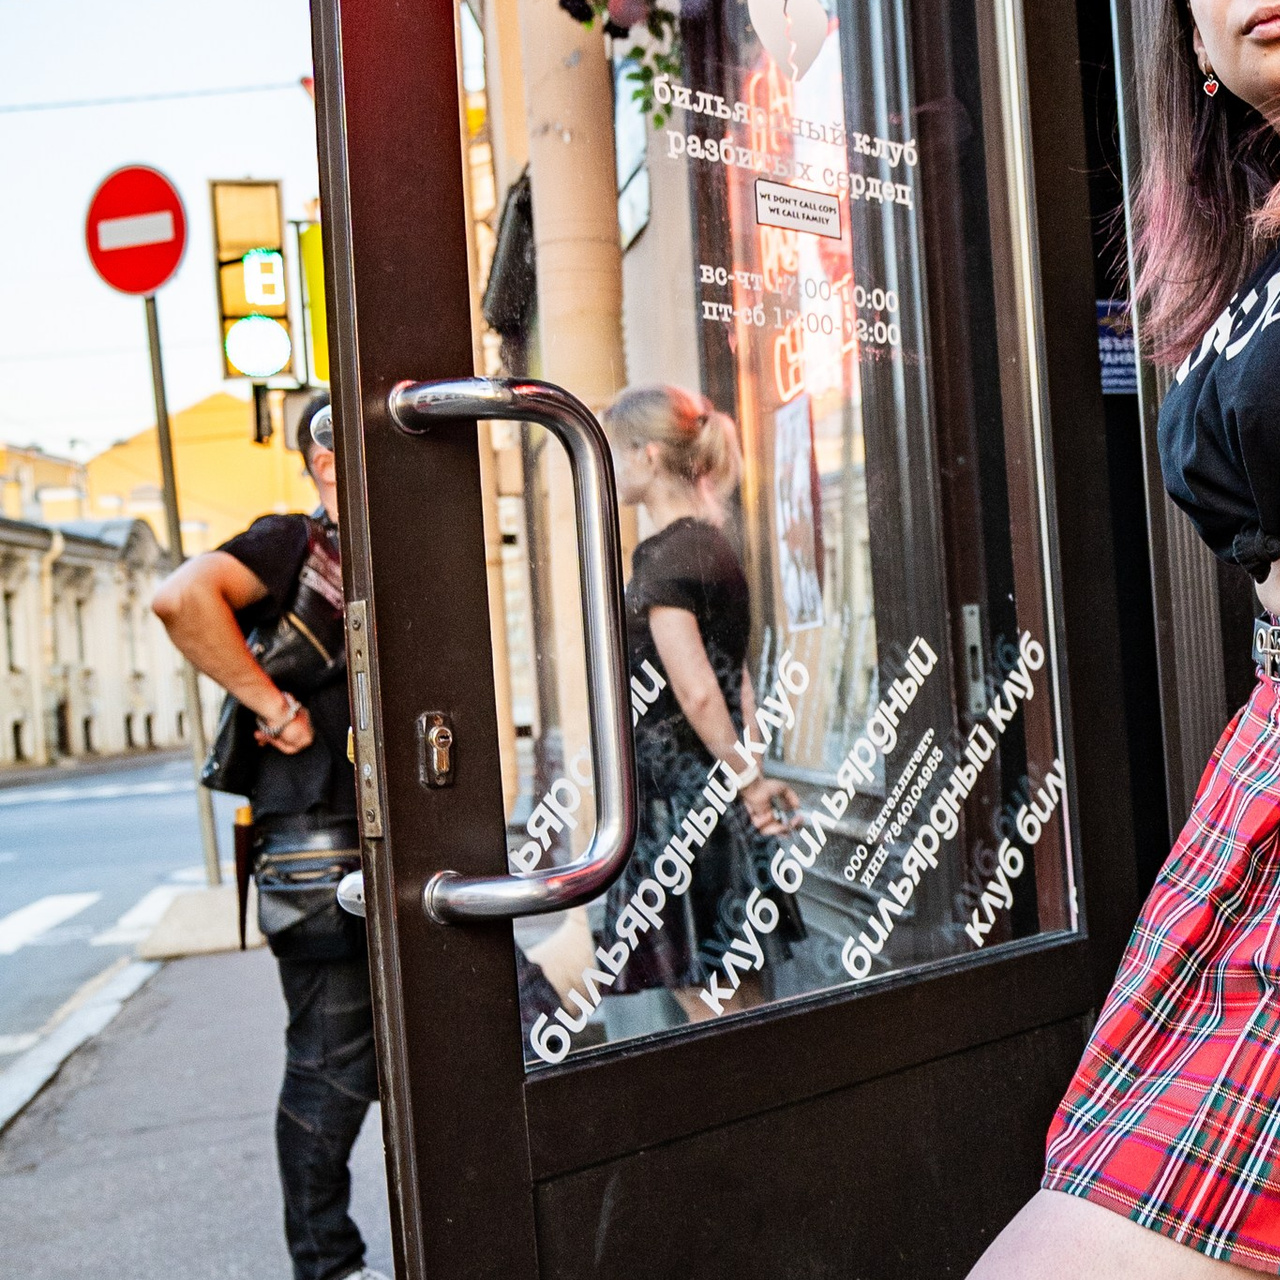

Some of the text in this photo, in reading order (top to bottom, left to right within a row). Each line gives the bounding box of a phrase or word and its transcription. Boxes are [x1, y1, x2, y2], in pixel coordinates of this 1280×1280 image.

[653, 73, 918, 168] бильярдный клуб
[666, 129, 914, 211] разбитых сердец
[760, 192, 837, 215] WE DON'T CALL COPS
[769, 206, 830, 225] WE CALL FAMILY
[699, 264, 899, 313] вс-чт 17:00-0:00
[701, 301, 766, 328] пт-сб
[700, 636, 938, 1016] клуб бильярдный
[841, 630, 1045, 980] бильярдный клуб
[860, 745, 944, 889] ИНН 7840104953
[530, 650, 810, 1064] бильярдный клуб
[844, 844, 868, 881] ООО
[964, 837, 1024, 947] клуб
